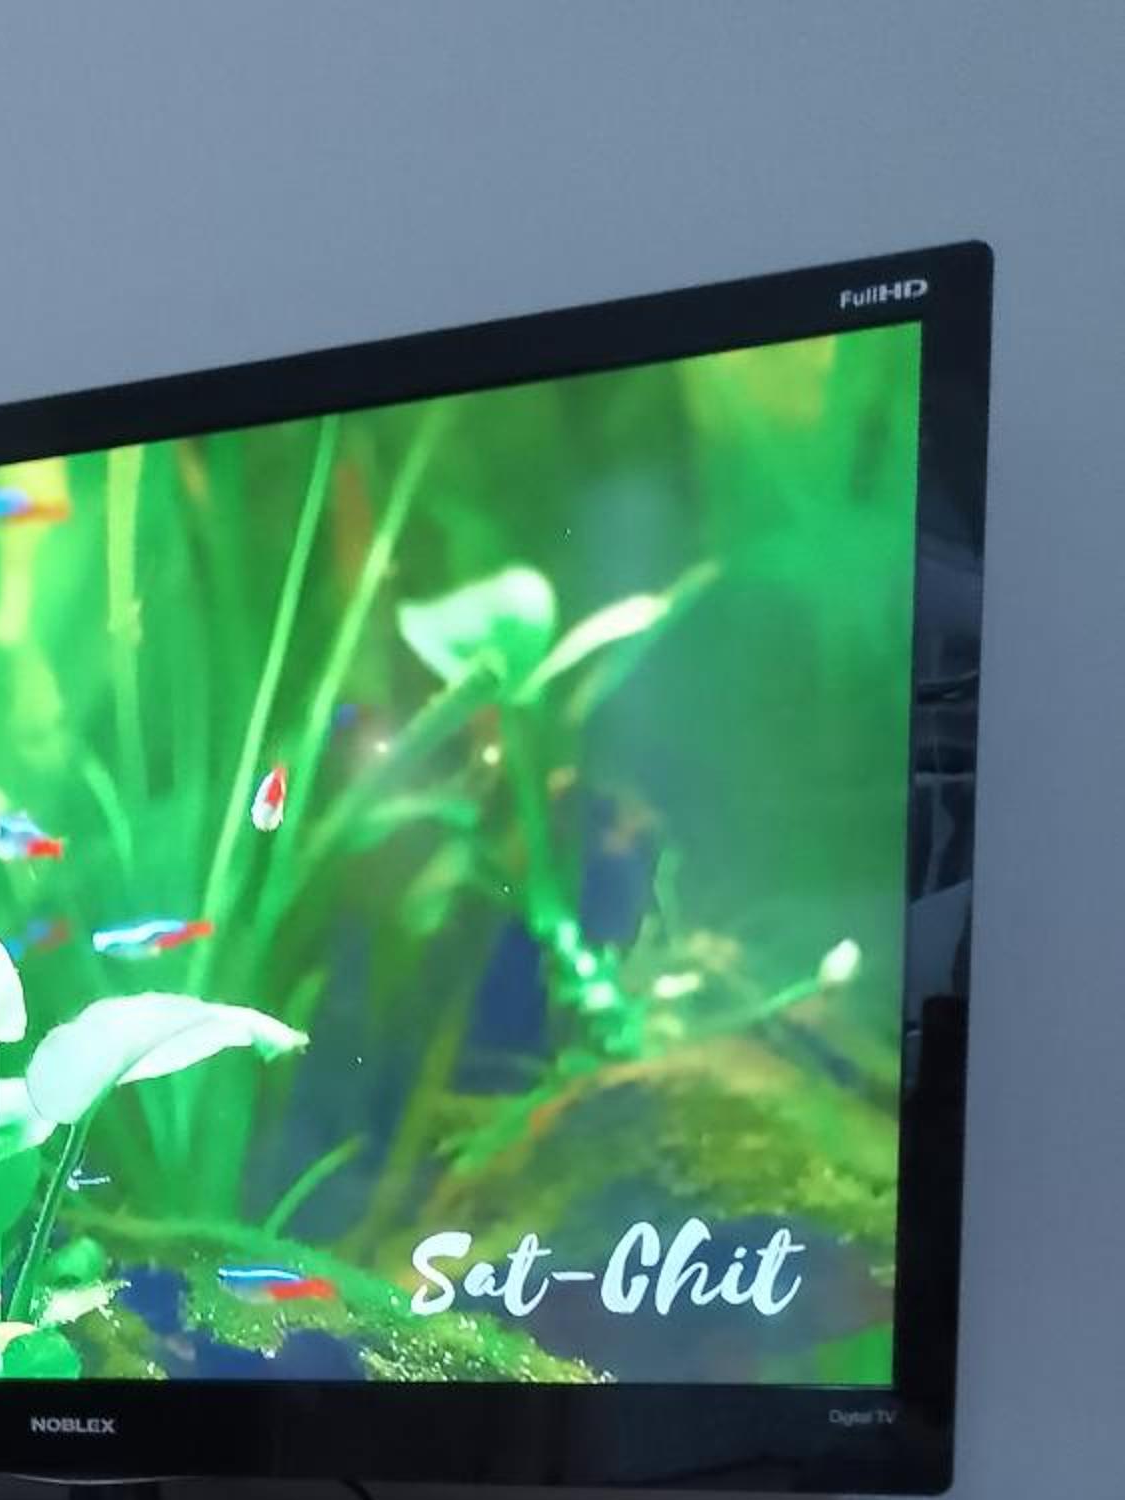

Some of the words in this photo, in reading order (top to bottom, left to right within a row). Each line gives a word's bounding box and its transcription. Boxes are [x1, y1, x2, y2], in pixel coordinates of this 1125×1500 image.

[410, 1216, 806, 1317] Sat-Chit
[30, 1416, 116, 1434] NOBLEX
[828, 1409, 873, 1427] Digital
[876, 1409, 898, 1424] TV
